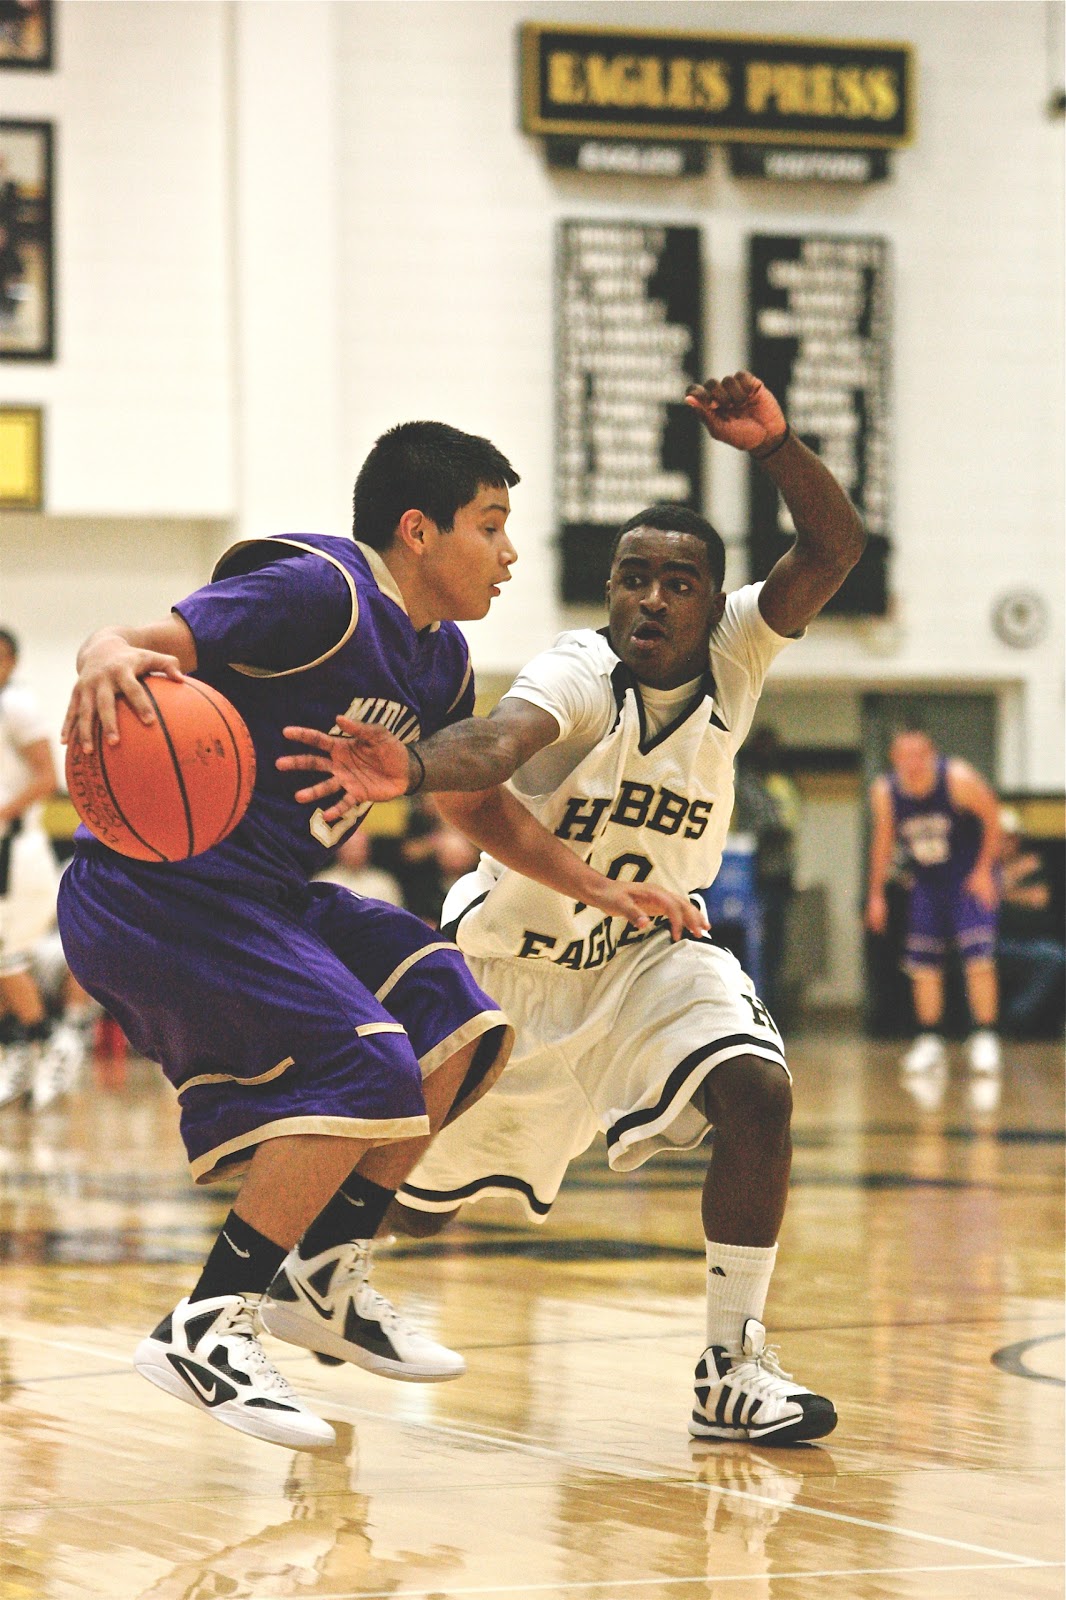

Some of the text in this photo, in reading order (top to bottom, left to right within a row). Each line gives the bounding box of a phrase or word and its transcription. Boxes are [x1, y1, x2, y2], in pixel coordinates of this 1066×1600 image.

[548, 51, 899, 121] EAGLES PRESS
[554, 780, 714, 843] HBBS
[516, 915, 671, 970] EAGLE
